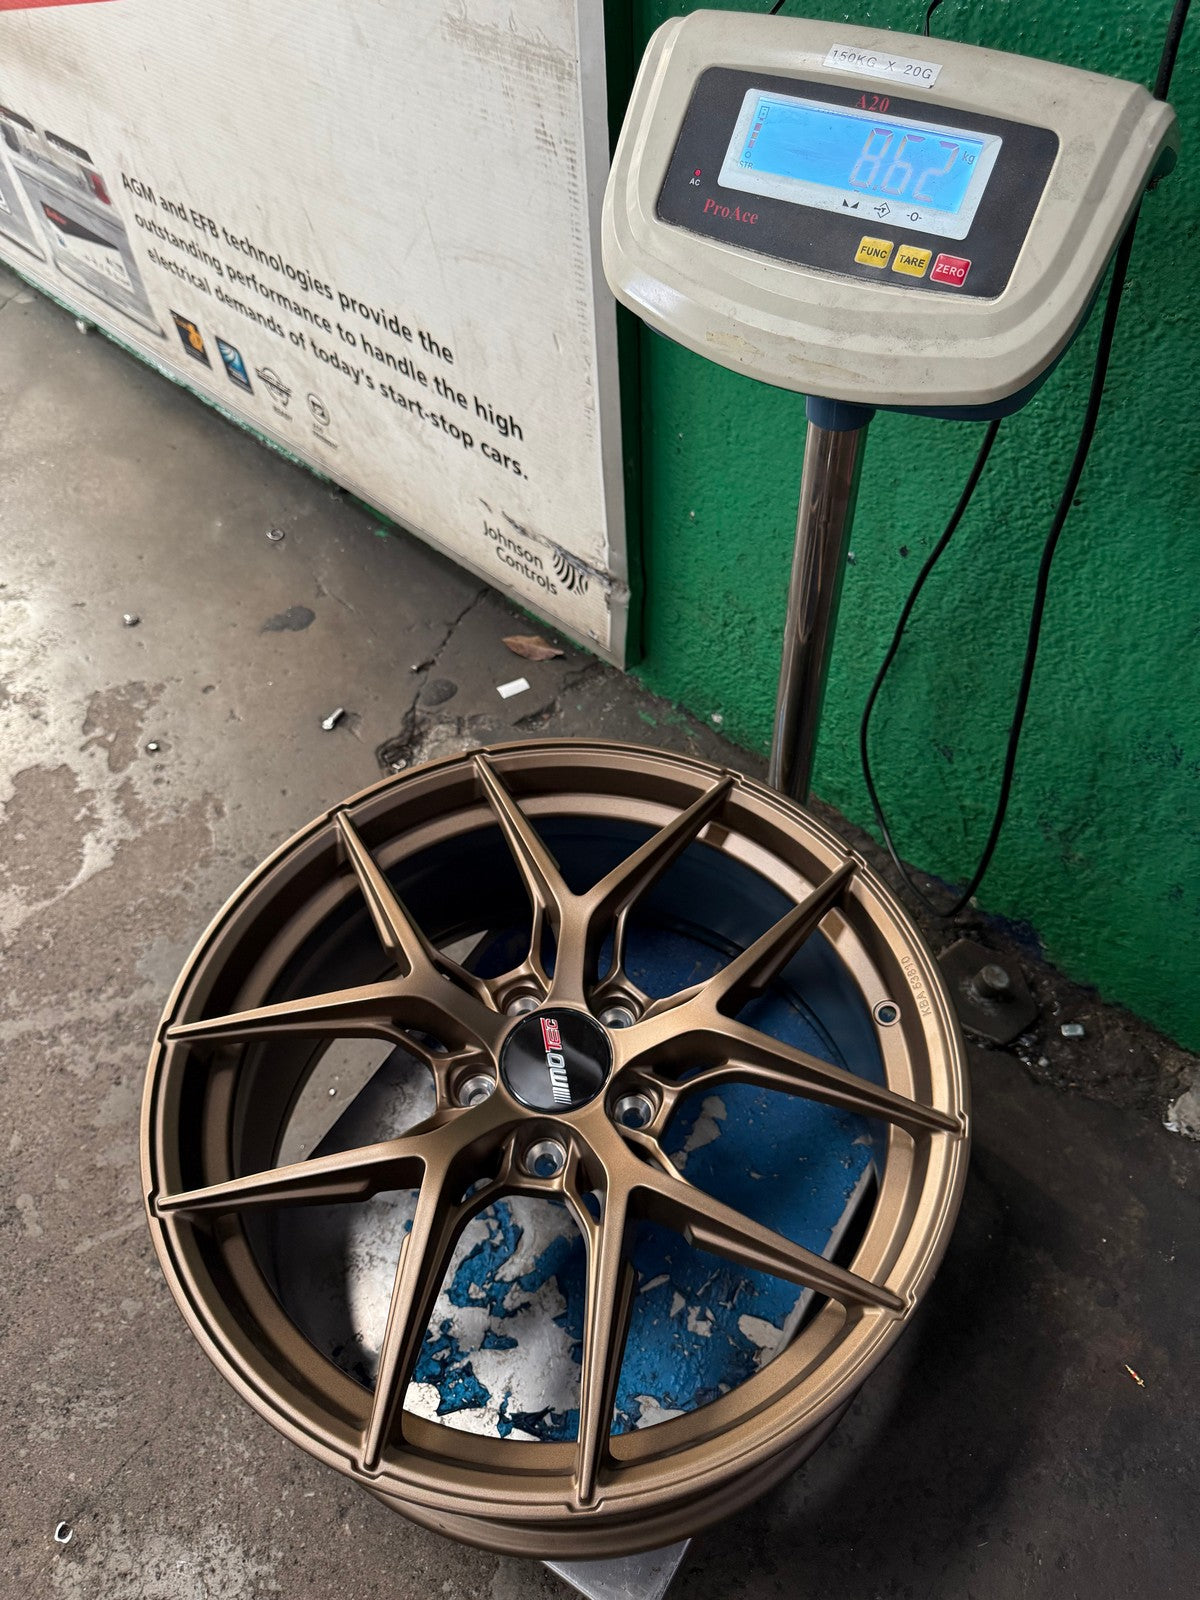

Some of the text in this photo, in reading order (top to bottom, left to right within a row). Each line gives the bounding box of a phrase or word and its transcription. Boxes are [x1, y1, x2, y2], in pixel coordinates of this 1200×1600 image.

[832, 49, 933, 80] 150KG X 20G
[854, 94, 890, 113] A20
[962, 150, 976, 166] kg
[689, 177, 701, 186] AC
[703, 197, 759, 225] ProAce
[860, 245, 888, 259] FUNC
[900, 254, 926, 268] TARE
[121, 172, 454, 365] AGM and EFB technologies provide the
[936, 263, 965, 278] ZERO
[135, 213, 224, 277] outstanding
[226, 264, 332, 334] performance
[336, 322, 356, 347] to
[360, 333, 428, 387] handle
[433, 376, 468, 410] the
[474, 396, 524, 441] high
[148, 249, 212, 296] electrical
[215, 286, 285, 338] demands
[289, 332, 307, 351] of
[311, 337, 375, 390] today's
[380, 383, 474, 449] start-stop
[481, 442, 529, 480] cars.
[483, 520, 543, 570] Johnson
[496, 546, 558, 595] Controls
[917, 990, 932, 1017] KBA
